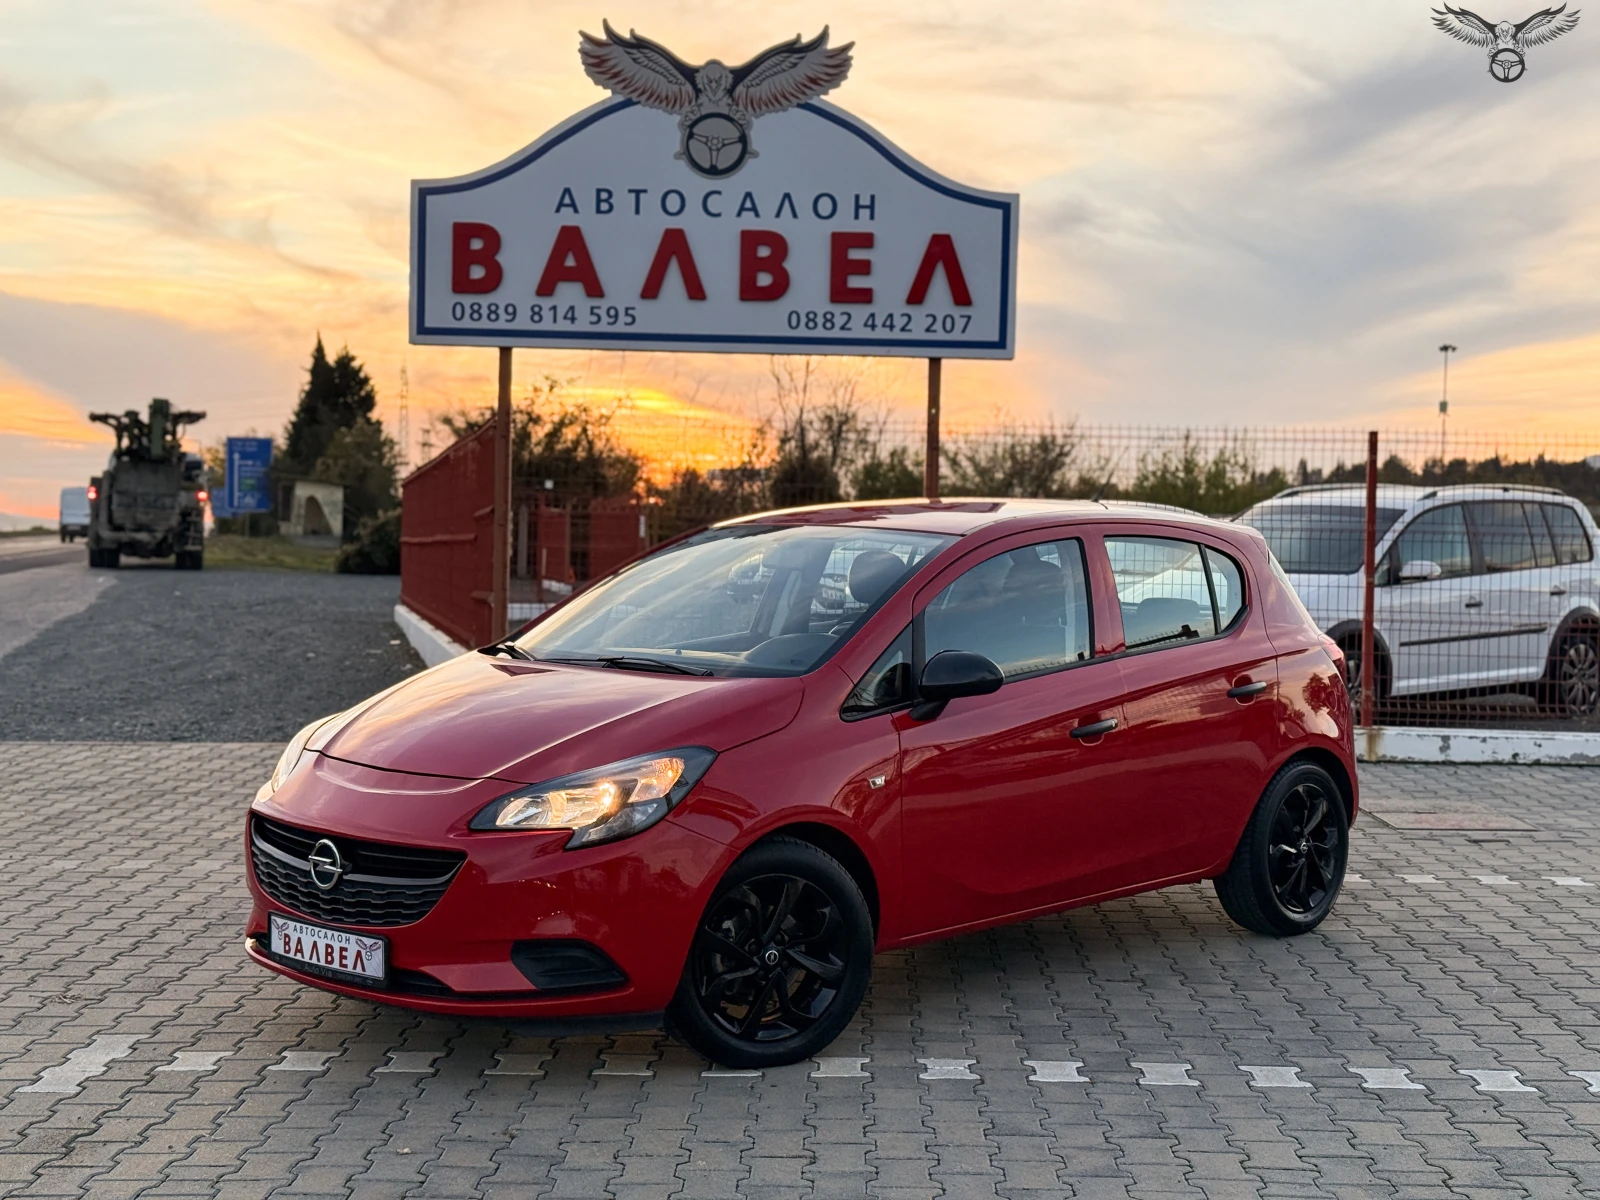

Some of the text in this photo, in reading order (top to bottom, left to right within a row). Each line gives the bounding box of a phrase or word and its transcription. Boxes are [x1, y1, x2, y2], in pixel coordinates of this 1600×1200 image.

[553, 185, 877, 222] АВТОСАЛОН
[451, 222, 973, 308] ВАЛВЕЛ
[451, 300, 637, 327] 0889 814 595
[786, 309, 973, 335] 0882 442 207
[293, 924, 351, 945] АВТОСАЛОН
[283, 932, 367, 973] ВАЛВЕЛ
